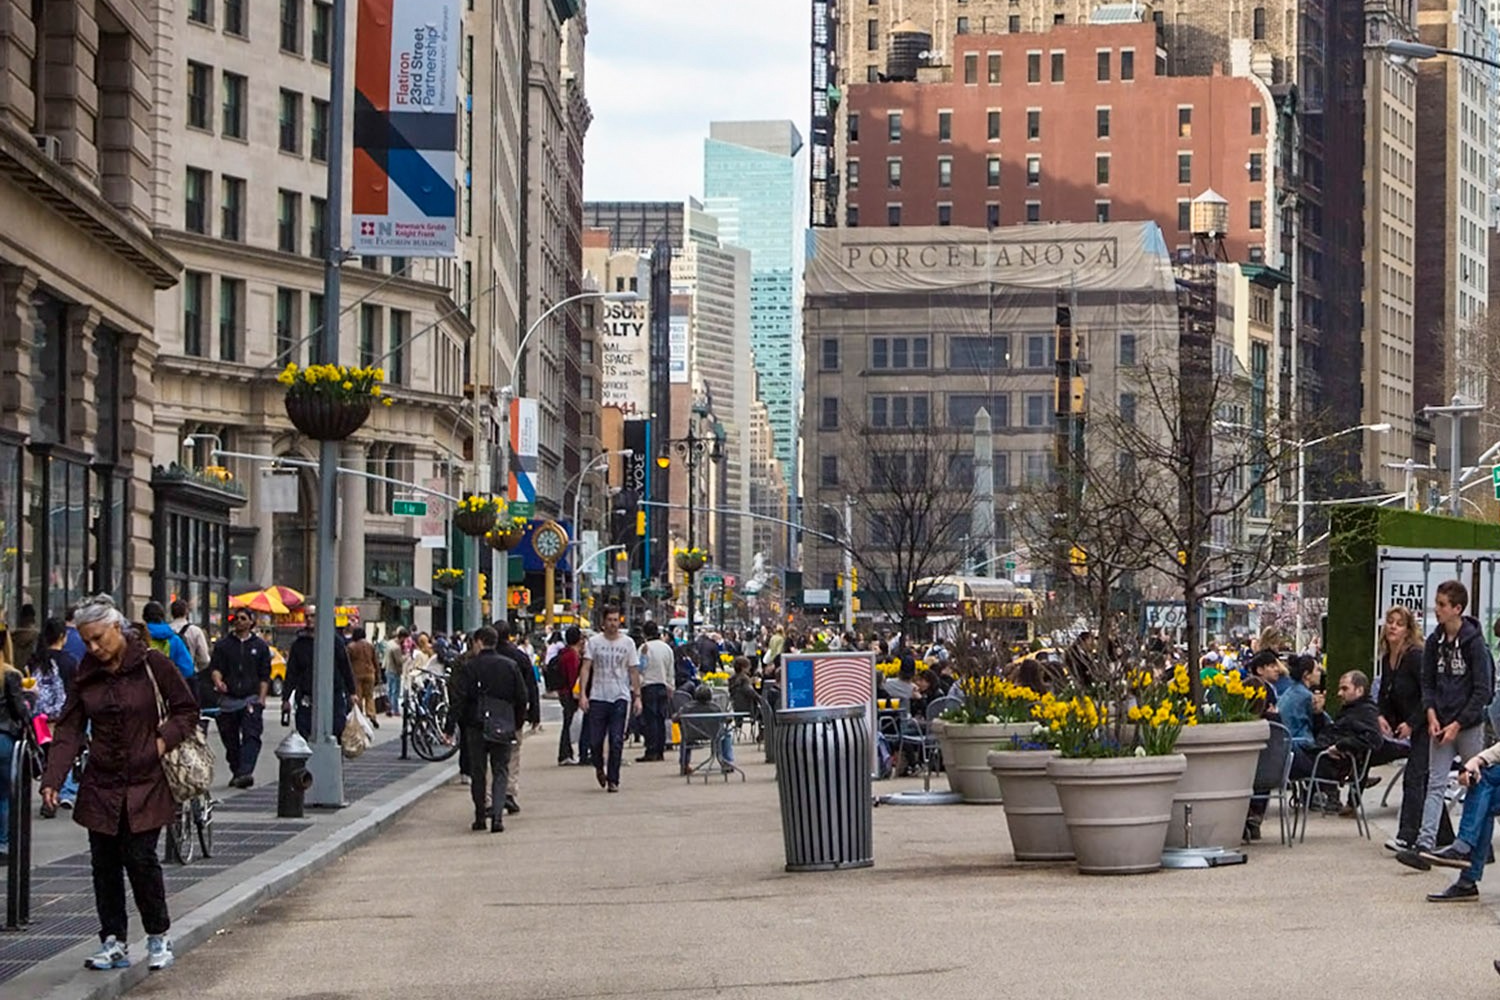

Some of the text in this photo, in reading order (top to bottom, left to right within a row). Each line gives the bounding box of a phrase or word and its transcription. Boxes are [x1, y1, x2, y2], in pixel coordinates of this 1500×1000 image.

[397, 52, 410, 105] Flatiron
[410, 28, 424, 105] 23rd Street
[423, 26, 440, 106] Partnership
[848, 242, 1114, 269] PORCELANOSA
[604, 354, 633, 365] SPACE
[1391, 584, 1424, 597] FLAT
[1391, 598, 1423, 610] IRON
